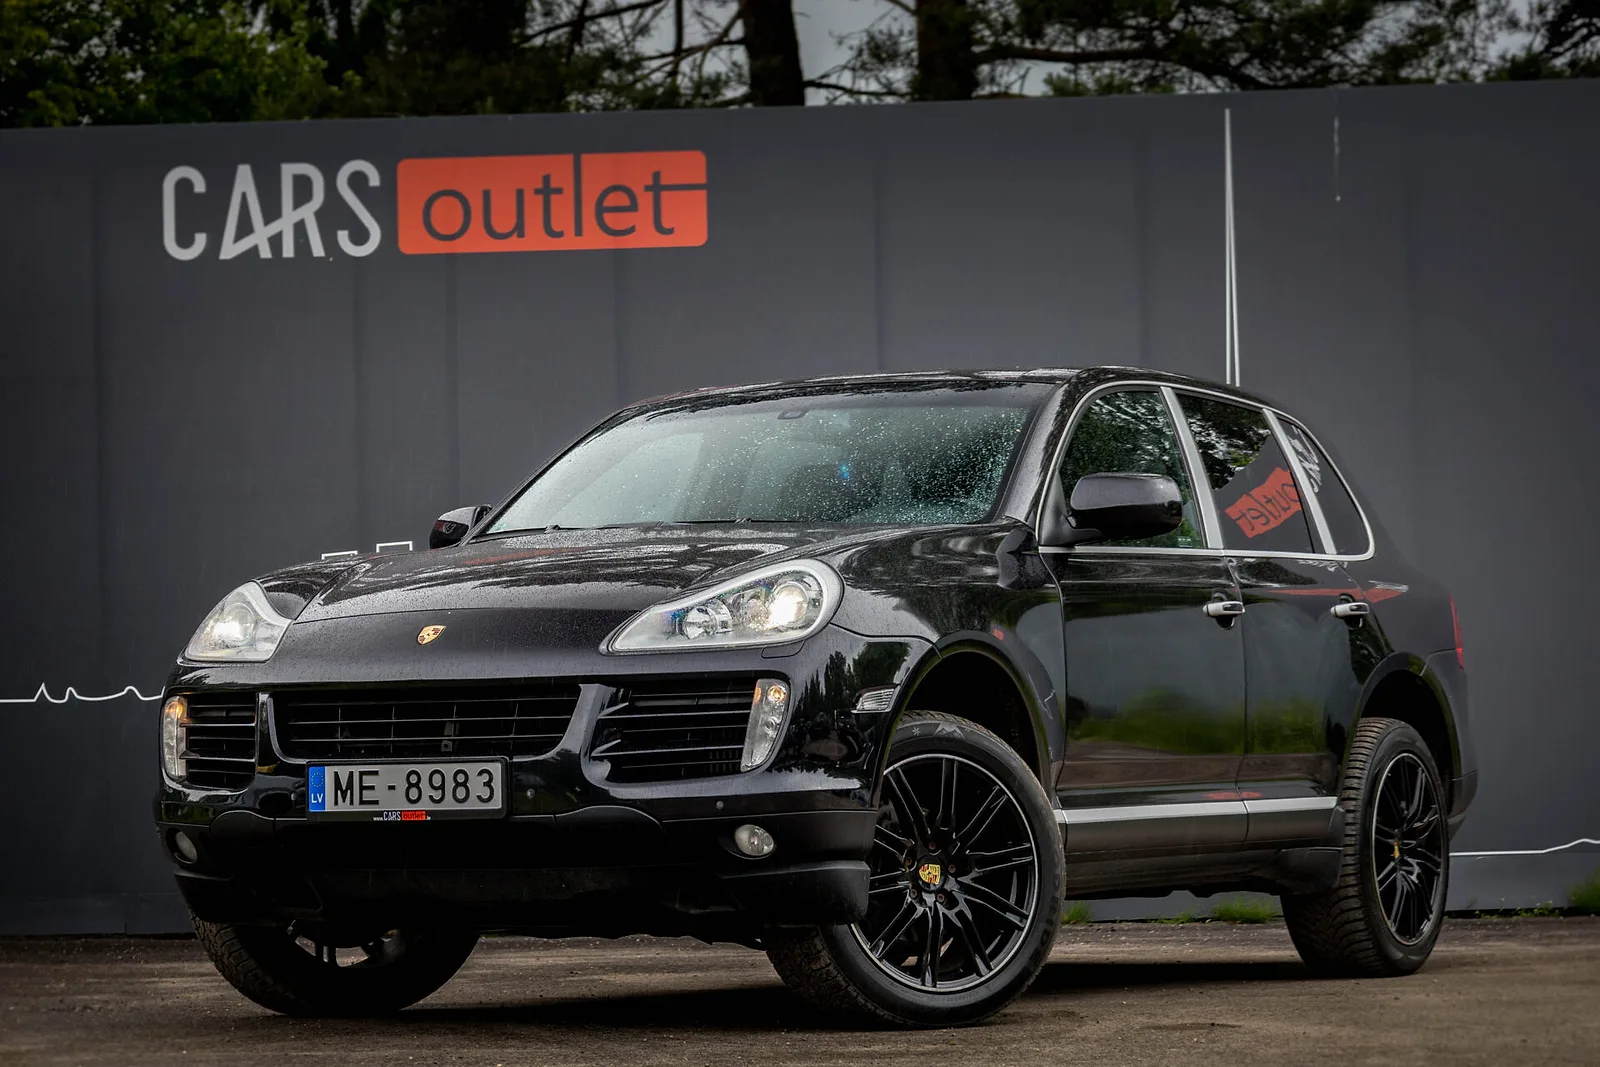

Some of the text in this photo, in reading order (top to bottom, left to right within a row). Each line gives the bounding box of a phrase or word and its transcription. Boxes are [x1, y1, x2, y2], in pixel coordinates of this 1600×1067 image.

[162, 153, 706, 261] CARS outlet
[311, 793, 324, 804] LV
